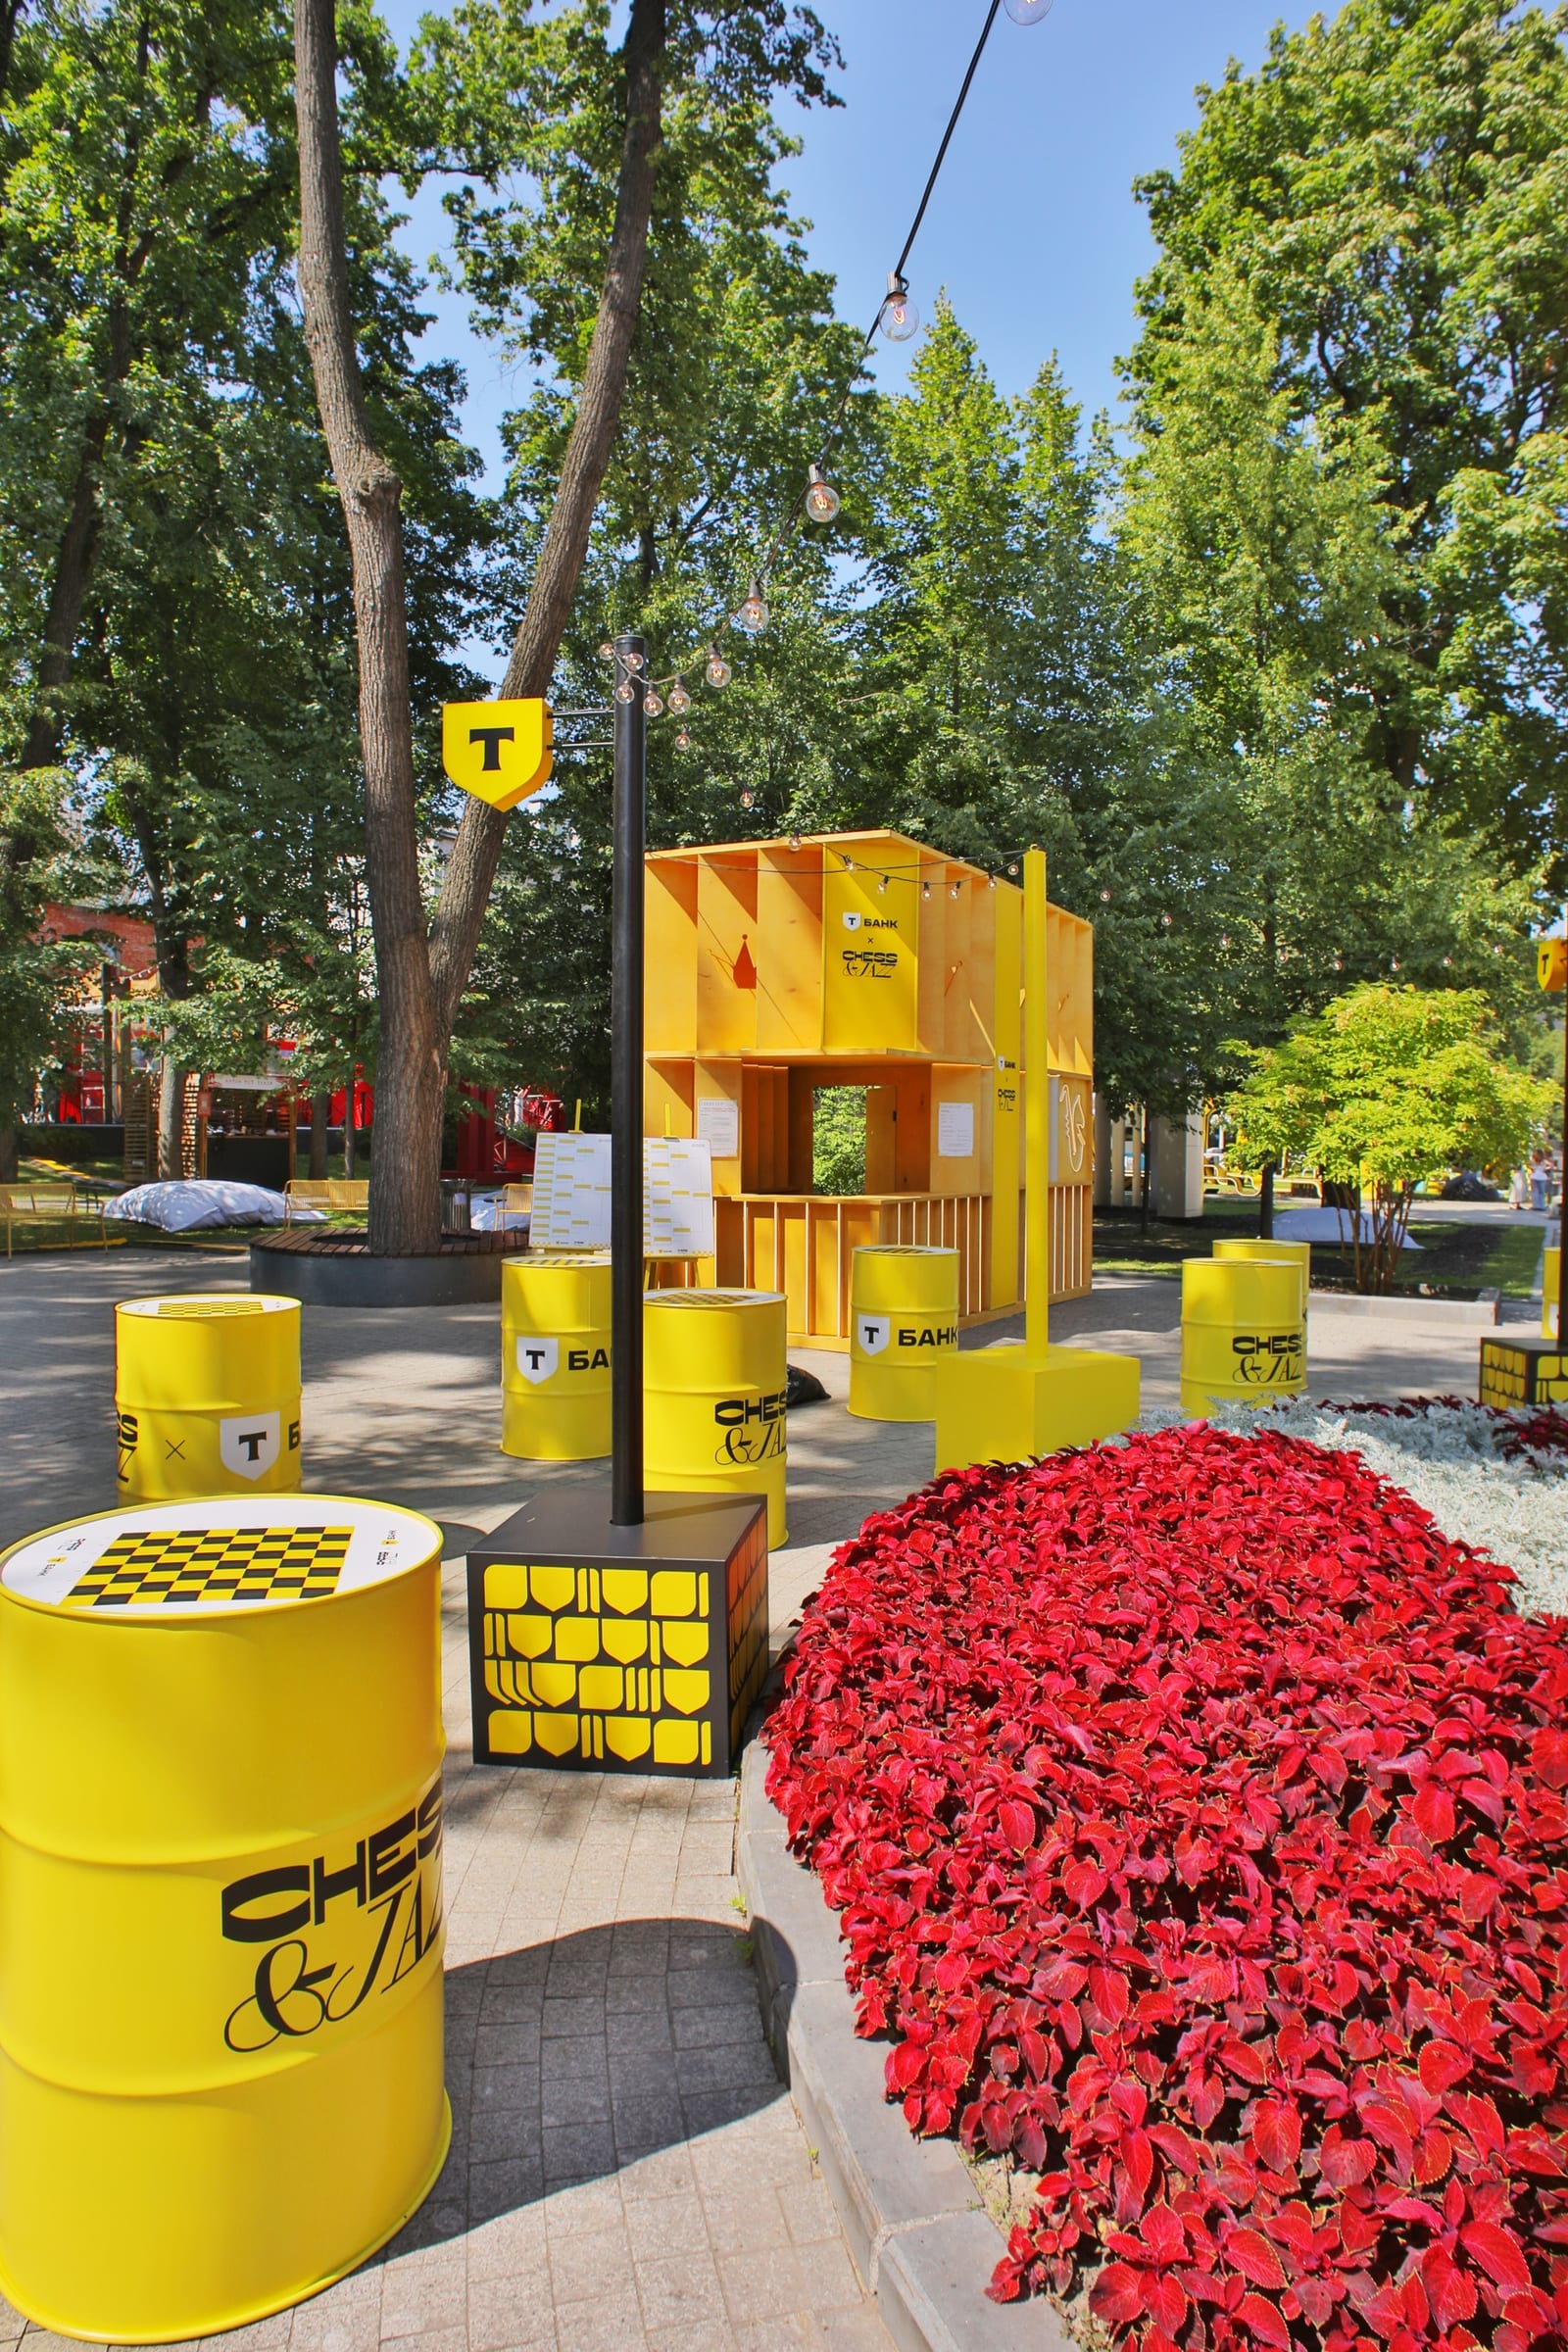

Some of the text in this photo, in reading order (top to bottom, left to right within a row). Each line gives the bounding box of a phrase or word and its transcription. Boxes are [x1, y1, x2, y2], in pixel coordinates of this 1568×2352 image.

[469, 727, 514, 771] Т
[863, 918, 899, 929] БАНК
[843, 951, 898, 963] CHESS
[864, 1326, 880, 1345] Т
[1233, 1334, 1301, 1355] CHES
[526, 1348, 612, 1371] Т БА
[238, 1431, 268, 1461] Т
[221, 1776, 443, 1943] CHES
